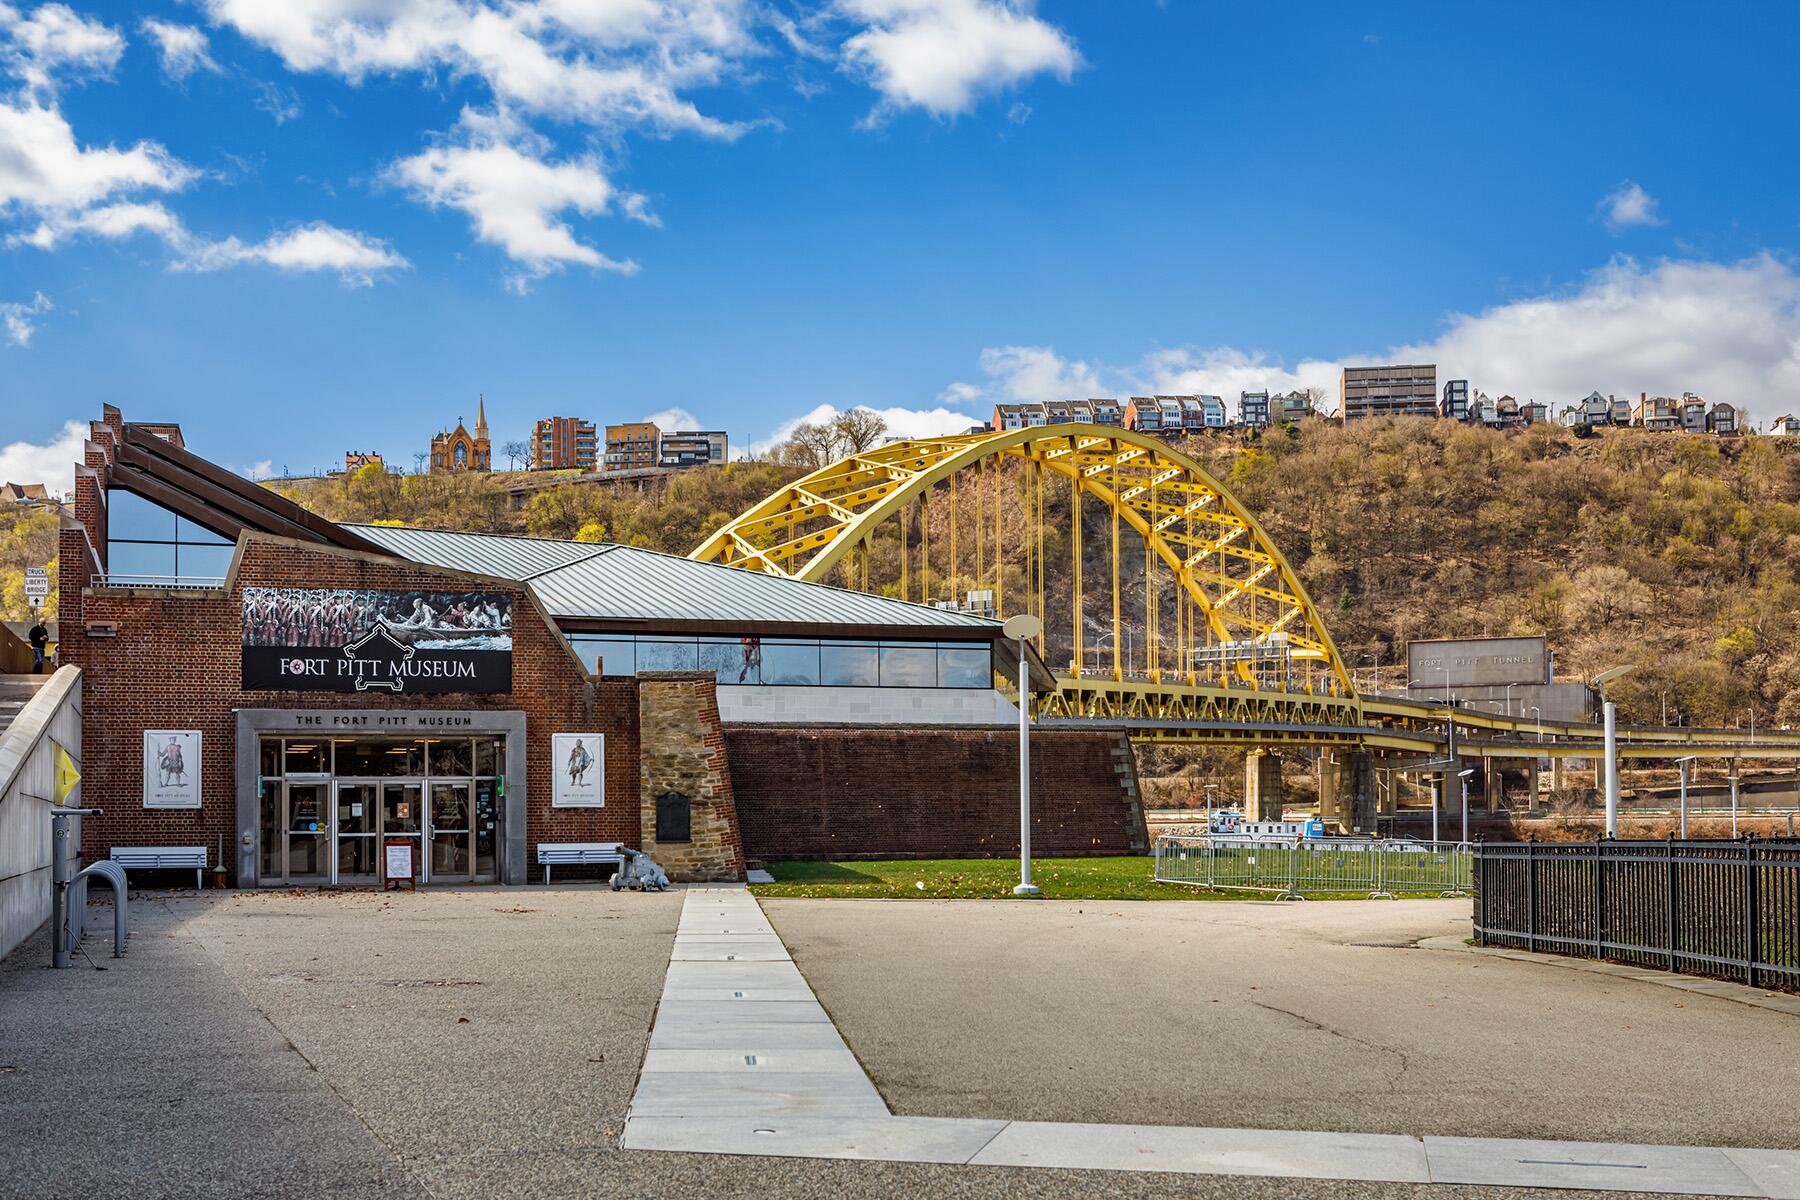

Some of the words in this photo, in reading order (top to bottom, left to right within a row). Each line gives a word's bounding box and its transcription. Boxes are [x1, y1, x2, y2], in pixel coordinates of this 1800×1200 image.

[1418, 658, 1442, 667] FORT
[1455, 656, 1480, 665] PITT
[1493, 656, 1535, 665] TUNNEL
[279, 657, 330, 676] FORT
[336, 658, 382, 677] PITT
[388, 659, 477, 678] MUSEUM
[296, 715, 322, 725] THE
[333, 716, 369, 725] FORT
[379, 716, 408, 725] PITT
[418, 717, 472, 726] MUSEUM
